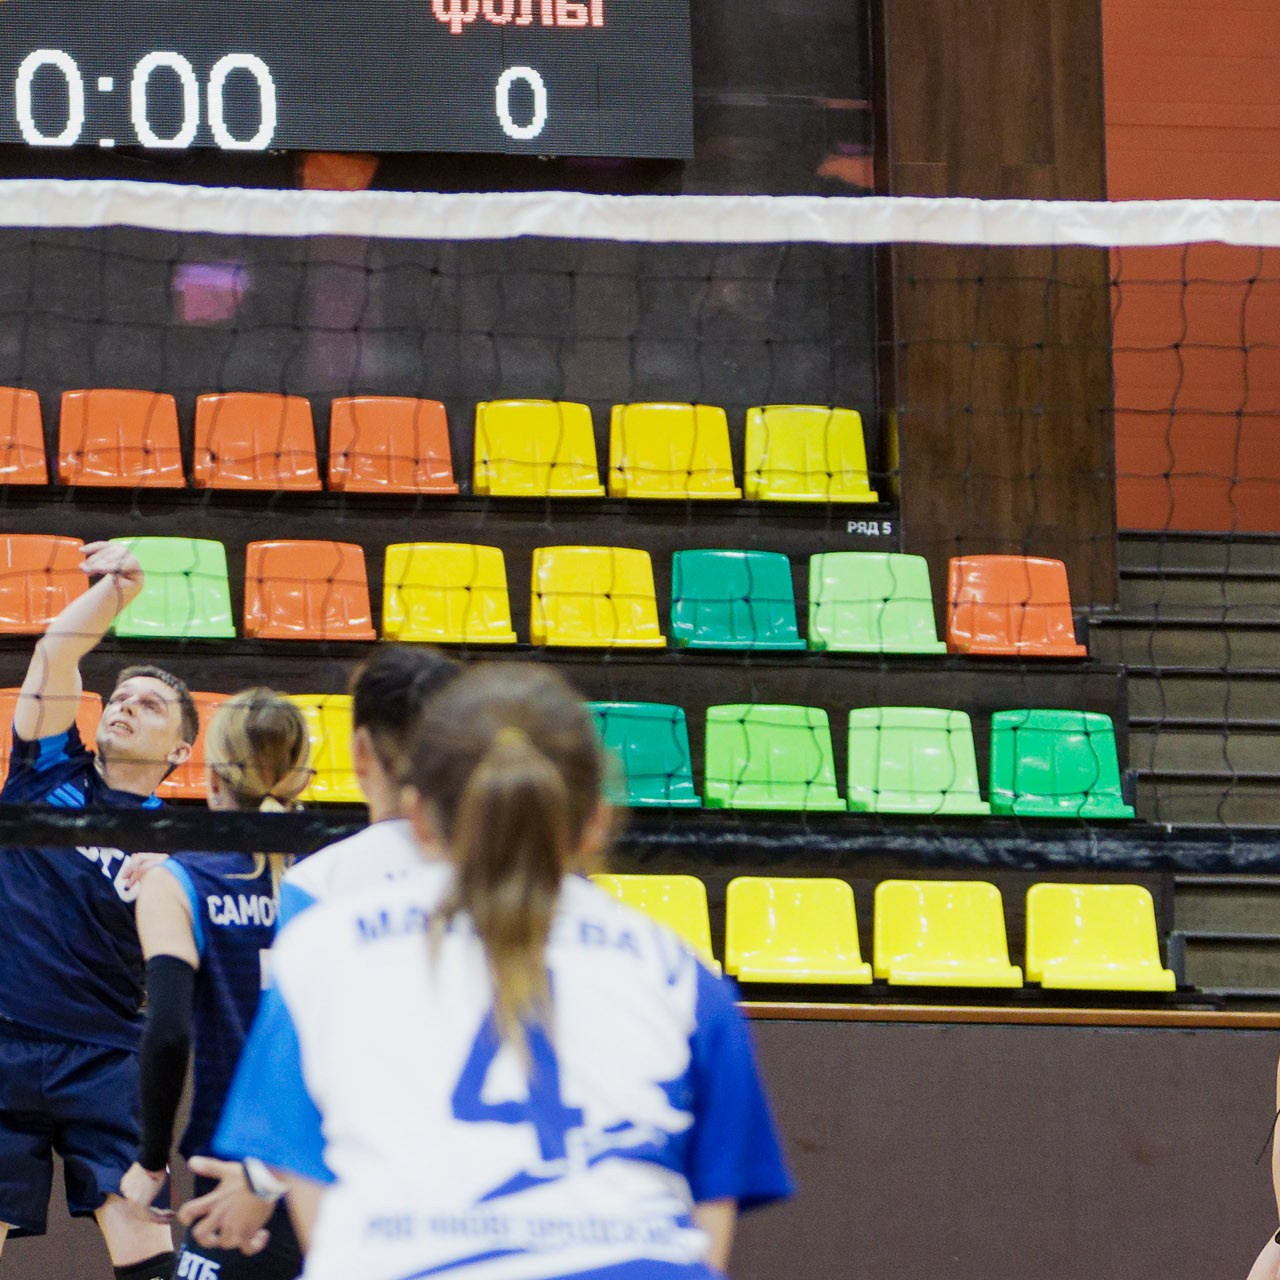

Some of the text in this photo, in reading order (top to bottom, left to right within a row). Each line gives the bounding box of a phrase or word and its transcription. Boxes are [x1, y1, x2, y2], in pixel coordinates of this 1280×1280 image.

[13, 48, 279, 152] 0:00
[494, 65, 549, 140] 0
[847, 521, 892, 536] РЯД 5
[451, 965, 584, 1162] 4
